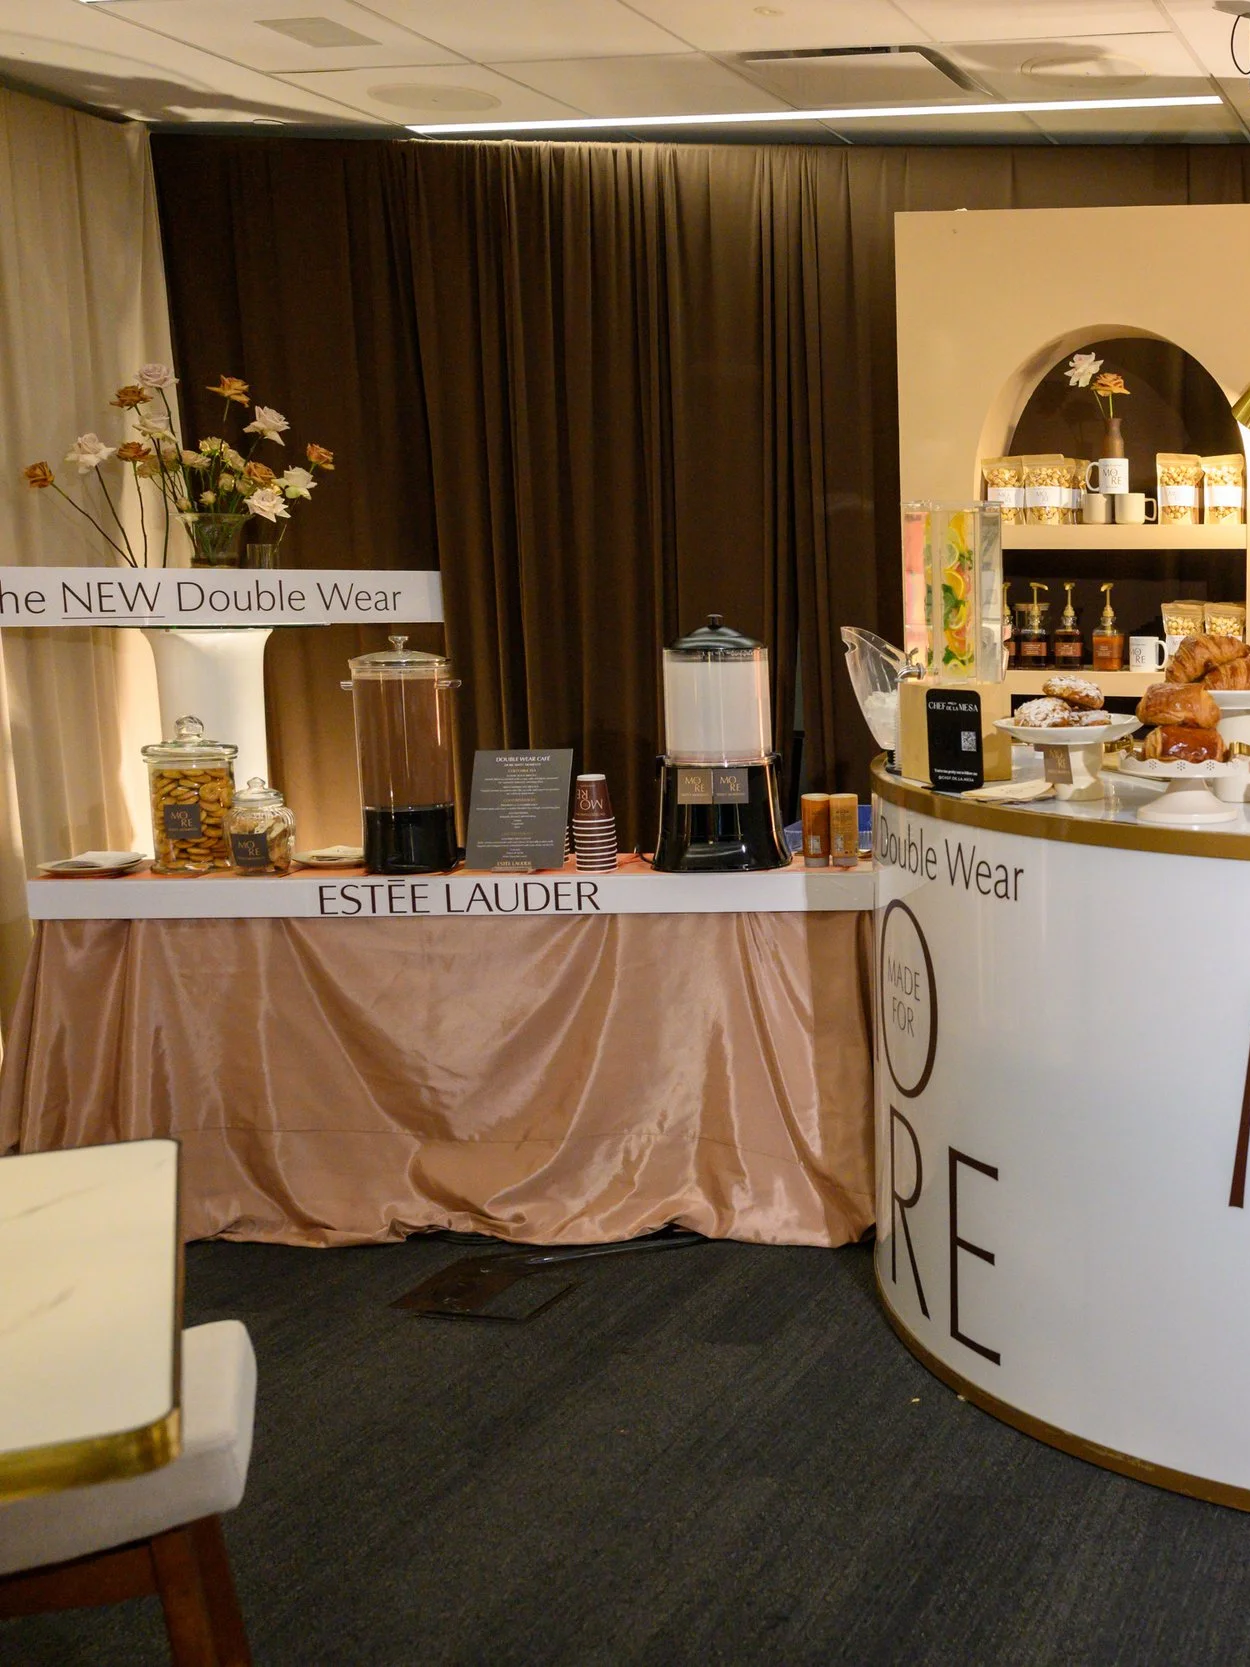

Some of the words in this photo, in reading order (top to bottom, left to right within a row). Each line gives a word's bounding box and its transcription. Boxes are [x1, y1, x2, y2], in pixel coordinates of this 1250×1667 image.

[0, 580, 46, 614] he
[61, 582, 161, 613] NEW
[176, 580, 306, 612] Double
[316, 582, 402, 612] Wear
[928, 701, 946, 710] CHEF
[958, 703, 979, 712] MESA
[685, 776, 702, 784] MO
[695, 784, 705, 792] RE
[719, 776, 737, 784] MO
[730, 784, 741, 792] RE
[880, 816, 938, 881] Double
[944, 838, 1024, 901] Wear
[445, 881, 600, 913] LAUDER
[887, 957, 921, 1001] MADE
[892, 997, 915, 1038] FOR
[890, 1104, 1001, 1367] RE
